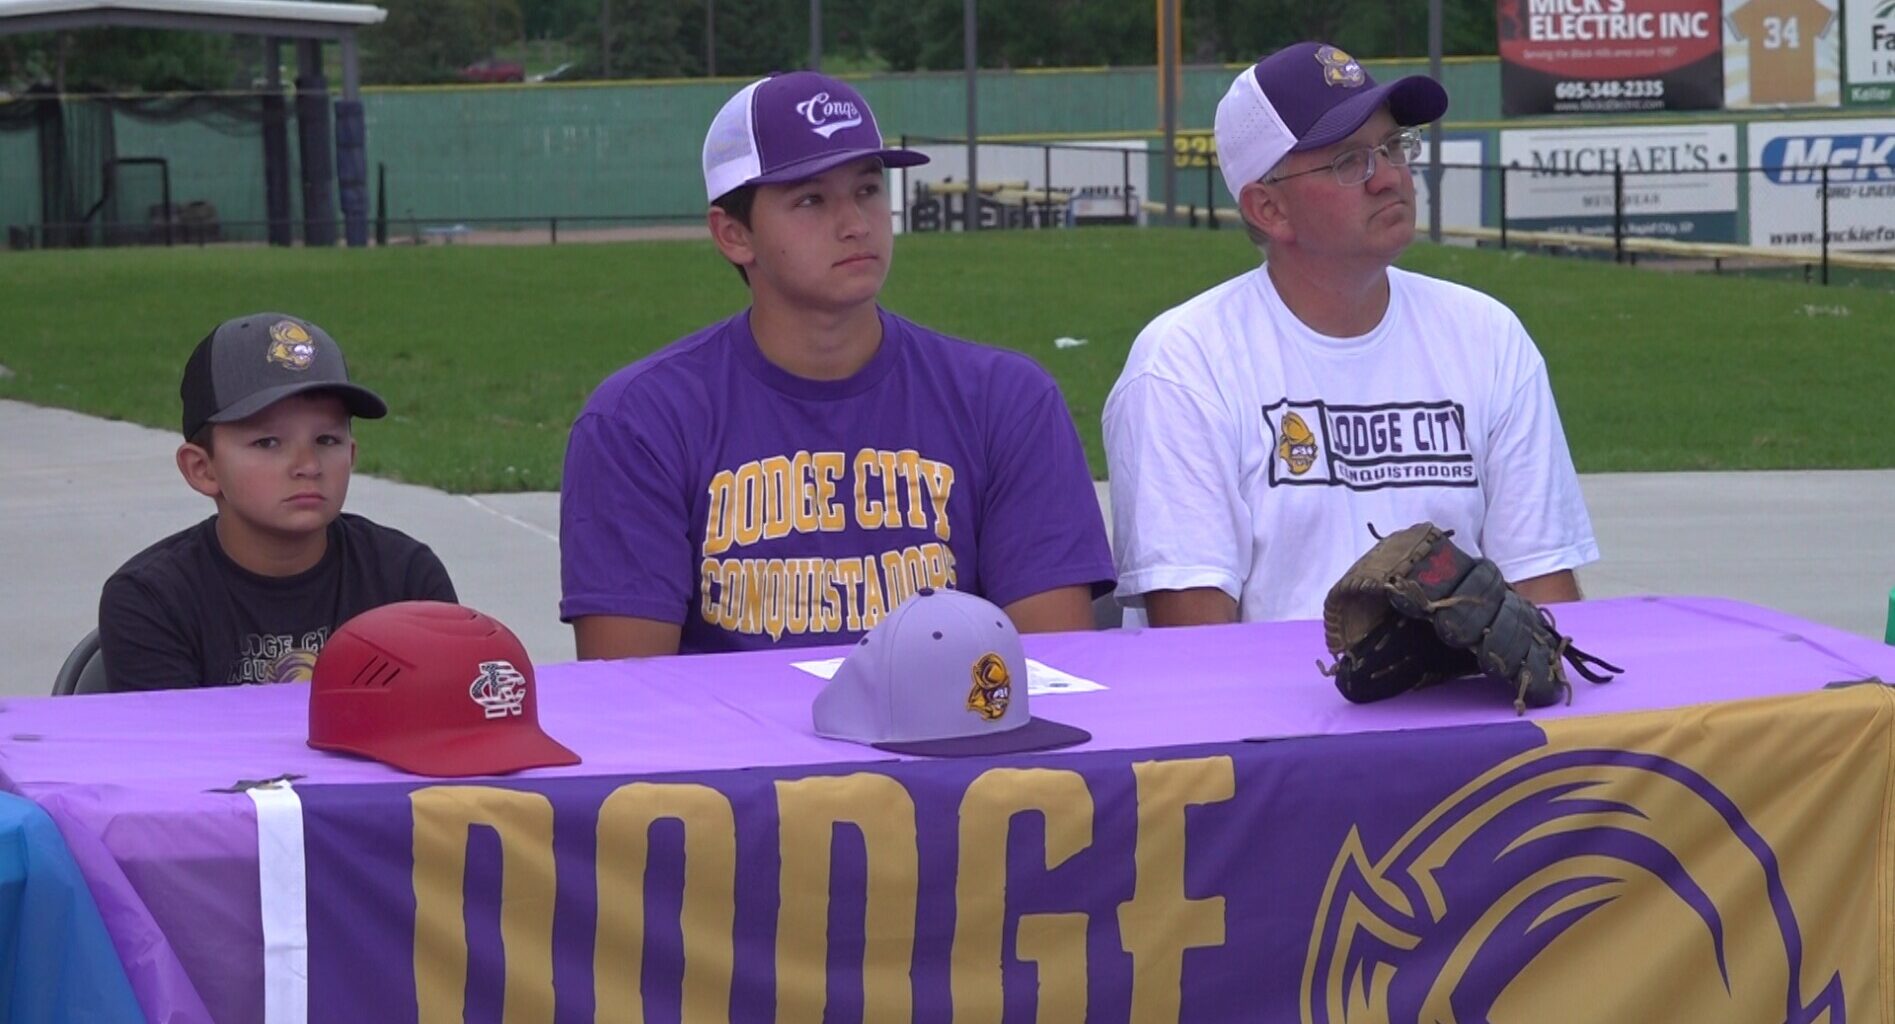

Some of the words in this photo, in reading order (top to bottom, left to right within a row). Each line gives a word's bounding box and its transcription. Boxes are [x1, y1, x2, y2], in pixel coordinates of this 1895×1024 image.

[1529, 13, 1655, 40] ELECTRIC
[1660, 12, 1711, 38] INC
[1763, 16, 1799, 49] 34
[1872, 25, 1895, 50] Fa
[1555, 80, 1664, 98] 605-348-2335
[1851, 87, 1891, 101] Keller
[1531, 144, 1709, 178] MICHAEL'S
[1778, 136, 1895, 182] McK
[1413, 410, 1467, 453] CITY
[703, 450, 846, 557] DODGE
[853, 448, 955, 542] CITY
[407, 754, 1236, 1024] DODGE
